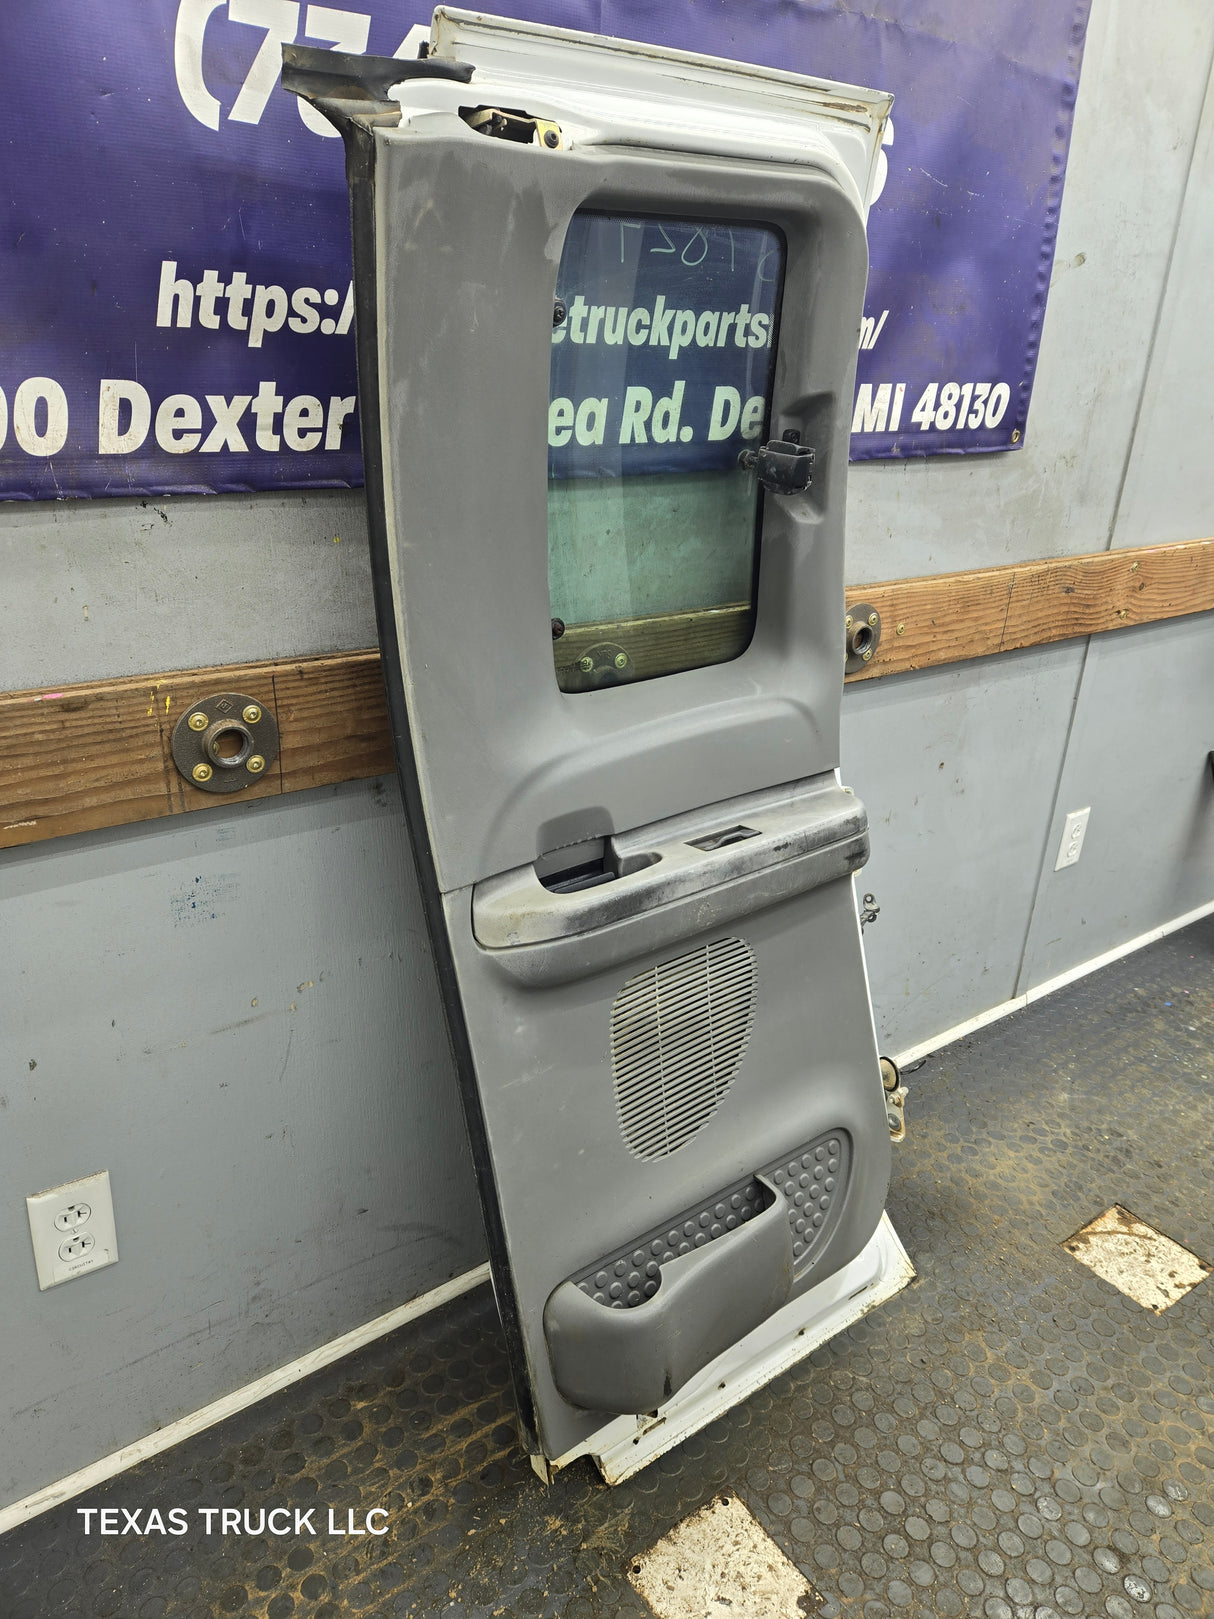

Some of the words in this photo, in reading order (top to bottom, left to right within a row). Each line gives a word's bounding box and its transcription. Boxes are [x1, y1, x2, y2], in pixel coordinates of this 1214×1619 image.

[0, 376, 69, 457] 0
[98, 379, 357, 455] Dexter
[618, 380, 694, 444] Rd.
[851, 383, 907, 433] MI
[911, 382, 1011, 431] 48130
